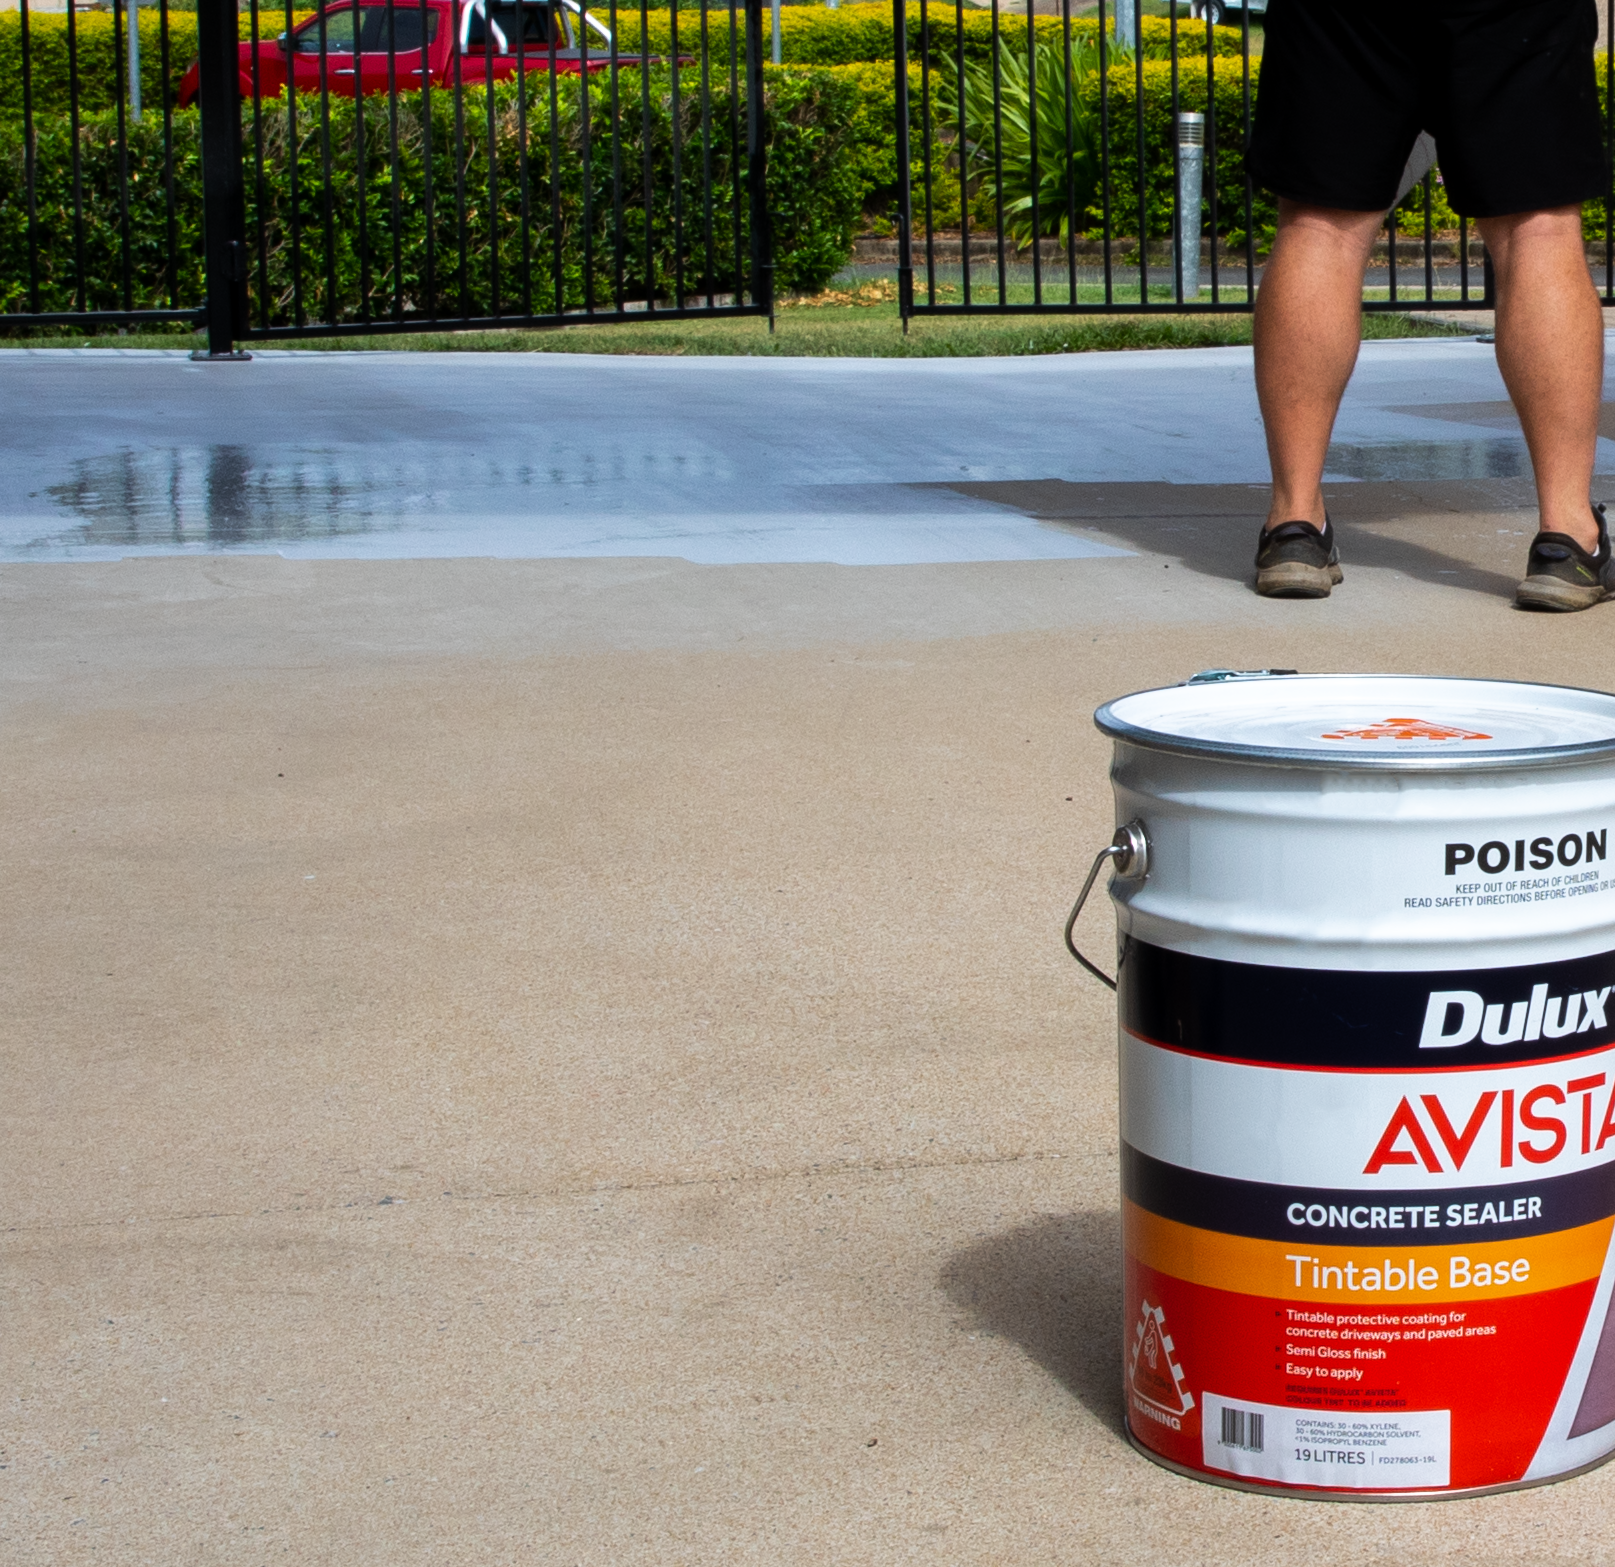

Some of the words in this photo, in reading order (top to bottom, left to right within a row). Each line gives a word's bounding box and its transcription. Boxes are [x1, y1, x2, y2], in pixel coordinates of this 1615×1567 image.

[1444, 828, 1608, 876] POISON
[1455, 883, 1481, 895] KEEP
[1483, 882, 1503, 893] OUT
[1505, 881, 1518, 892] OF
[1520, 878, 1550, 891] REACH
[1551, 876, 1563, 887] OF
[1564, 870, 1600, 886] CHILDREN
[1403, 897, 1433, 908] READ
[1435, 896, 1474, 908] SAFETY
[1476, 890, 1532, 907] DIRECTIONS
[1534, 887, 1566, 902] BEFORE
[1568, 883, 1599, 898] OPENING
[1600, 880, 1609, 892] OR
[1418, 983, 1612, 1049] Dulux
[1286, 1202, 1440, 1230] CONCRETE
[1446, 1196, 1542, 1227] SEALER
[1285, 1254, 1439, 1292] Tintable
[1449, 1255, 1531, 1289] Base
[1286, 1308, 1335, 1324] Tintable
[1336, 1312, 1400, 1327] protective
[1402, 1311, 1447, 1326] coating
[1449, 1311, 1467, 1323] for
[1285, 1326, 1339, 1339] concrete
[1340, 1328, 1401, 1343] driveways
[1402, 1328, 1426, 1340] and
[1427, 1325, 1464, 1342] paved
[1465, 1325, 1497, 1337] areas
[1285, 1343, 1316, 1357] Semi
[1317, 1345, 1352, 1359] Gloss
[1353, 1348, 1387, 1360] finish
[1285, 1362, 1314, 1379] Easy
[1315, 1365, 1329, 1377] to
[1330, 1367, 1364, 1381] apply
[1295, 1419, 1337, 1429] CONTAINS:
[1337, 1422, 1347, 1430] 30
[1296, 1427, 1305, 1435] 30
[1326, 1430, 1385, 1438] HYDROCARBON
[1311, 1437, 1351, 1446] ISOPROPYL
[1353, 1438, 1388, 1446] BENZENE
[1294, 1448, 1311, 1462] 19
[1314, 1450, 1366, 1465] LITRES
